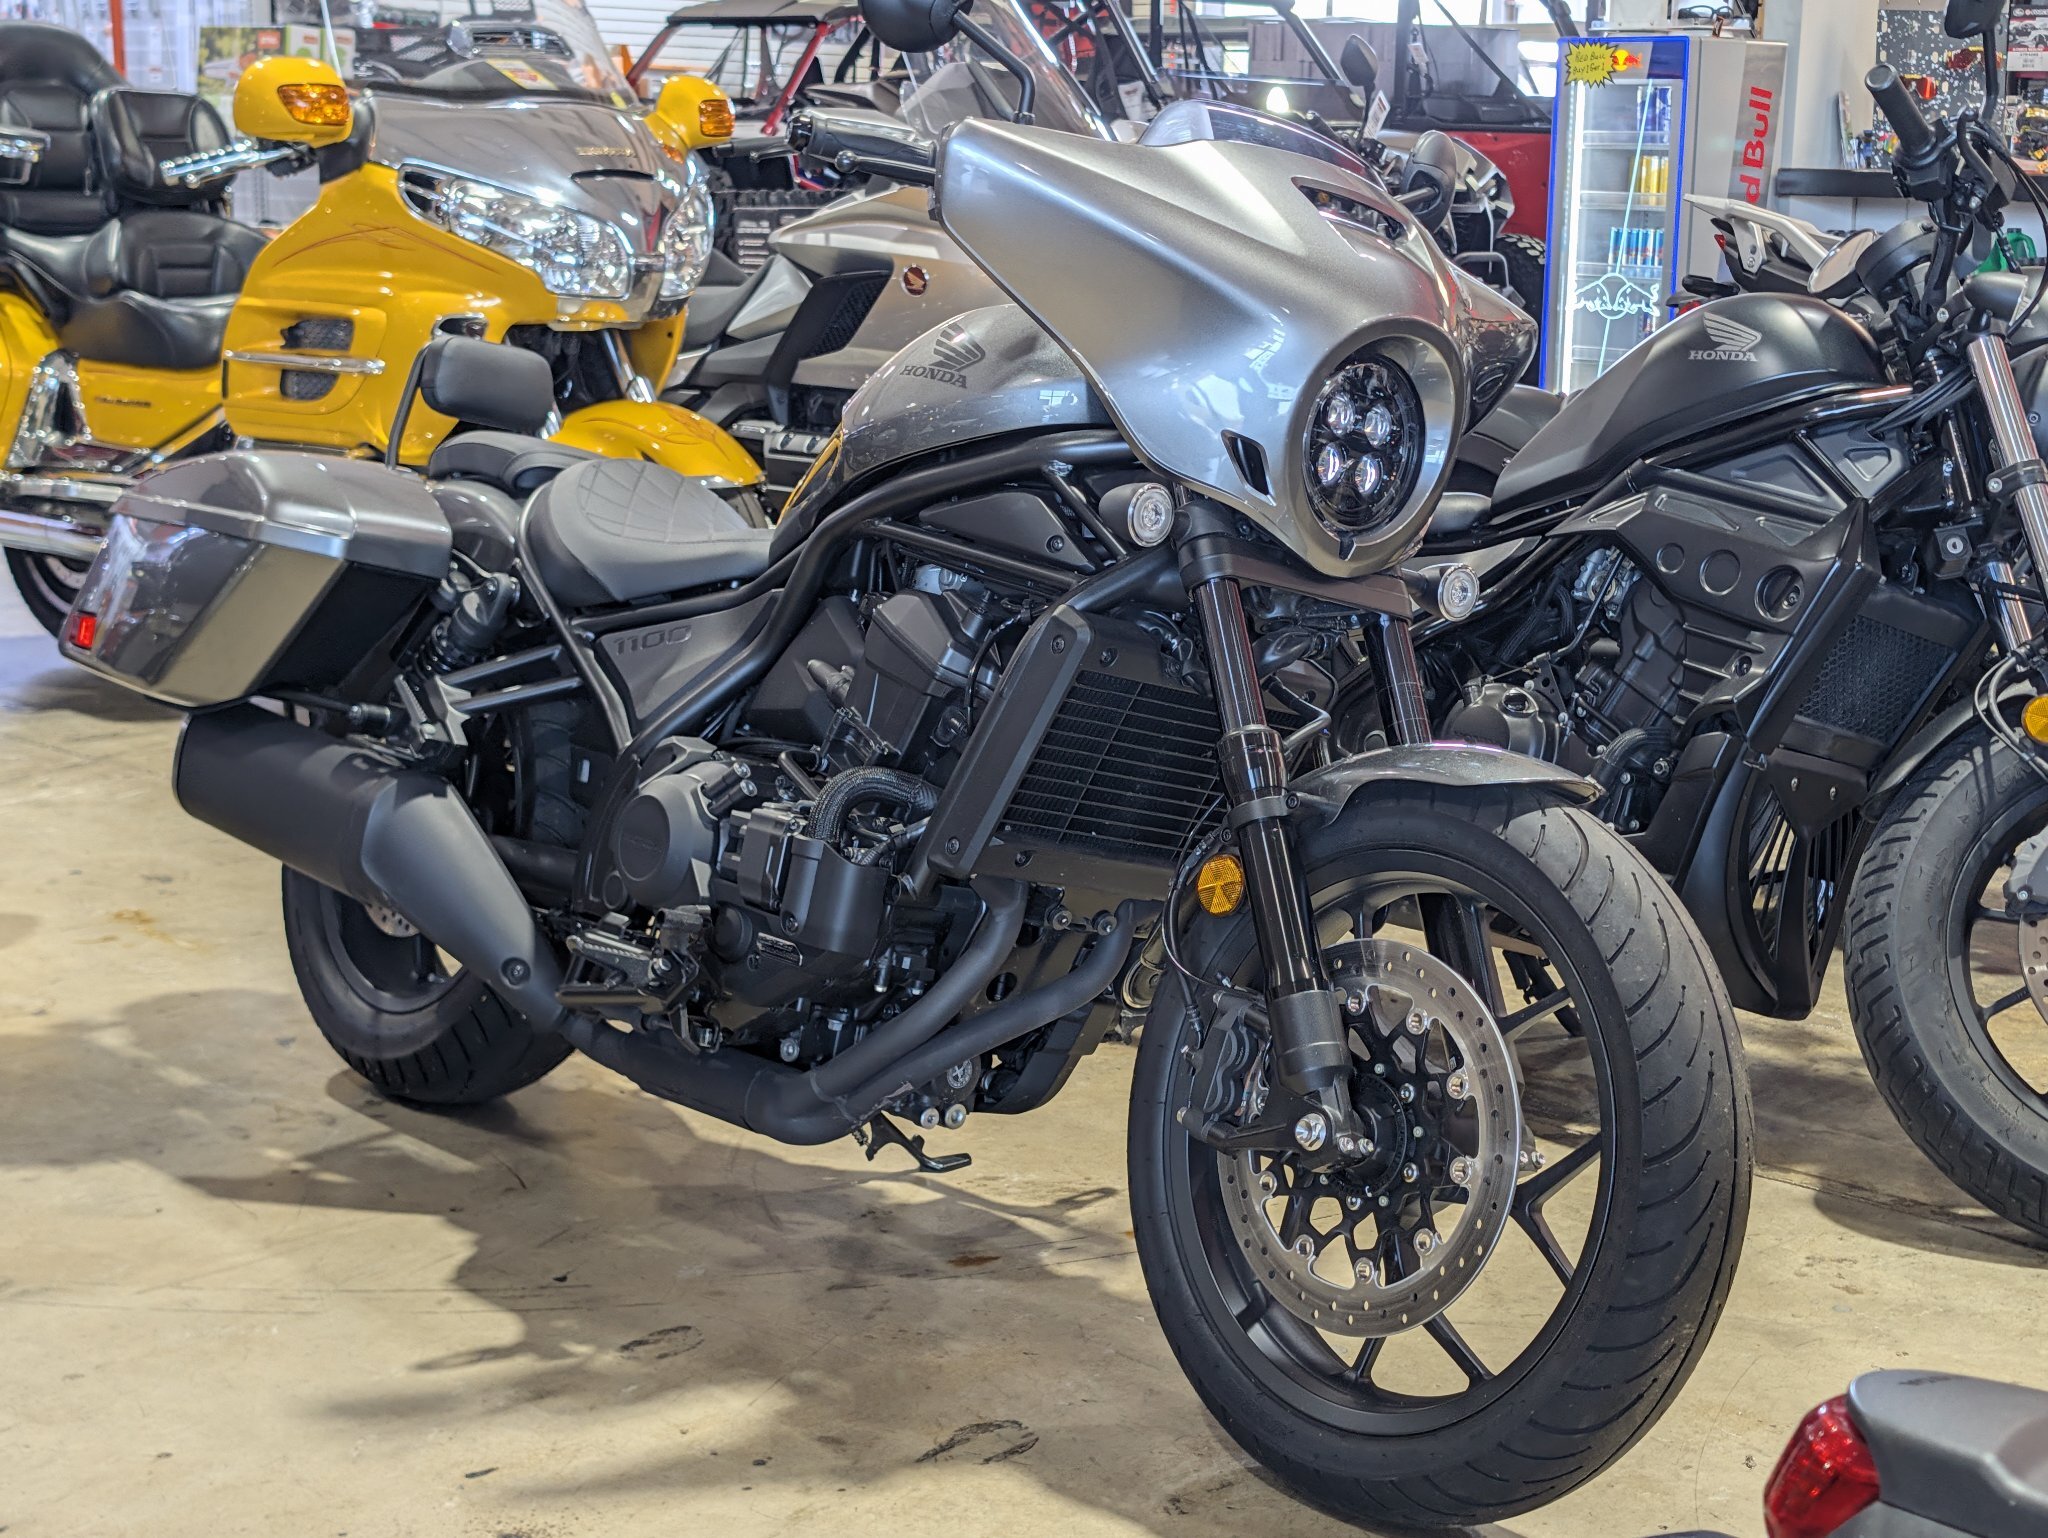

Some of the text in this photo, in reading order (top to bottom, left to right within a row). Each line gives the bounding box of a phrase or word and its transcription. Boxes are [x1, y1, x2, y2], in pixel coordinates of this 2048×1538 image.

[1743, 86, 1773, 169] Bull
[1688, 350, 1758, 361] HONDA
[900, 365, 967, 389] HONDA
[613, 624, 692, 655] 1100
